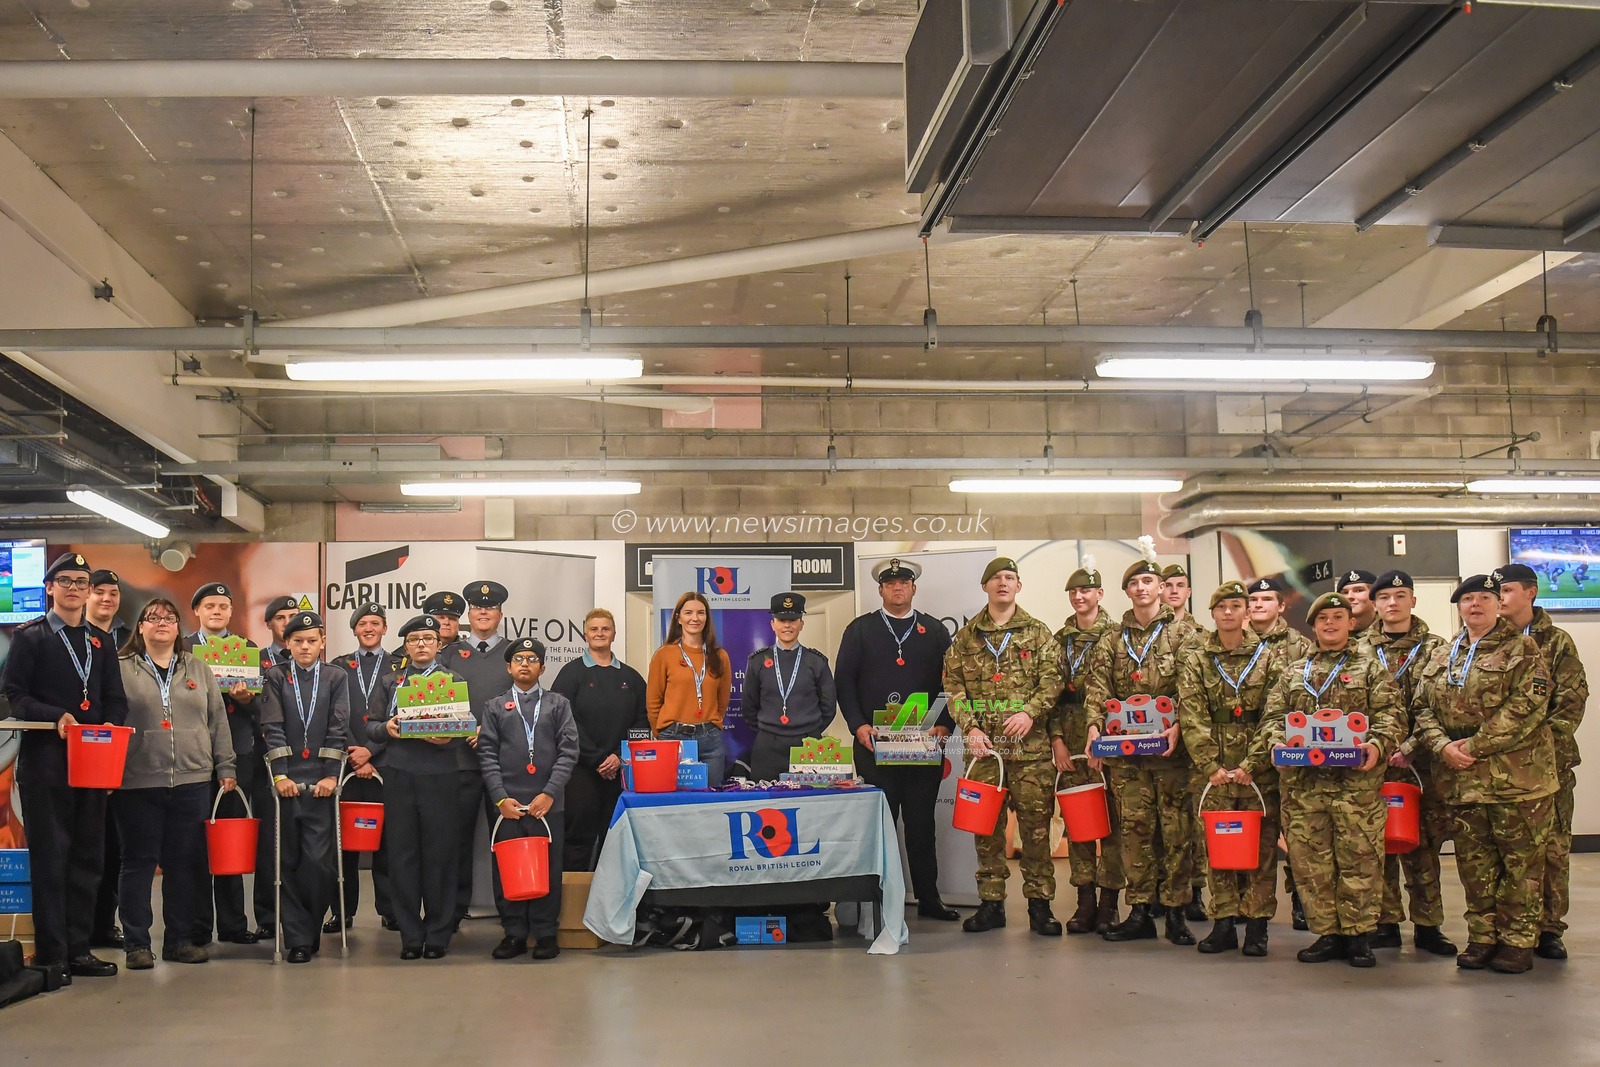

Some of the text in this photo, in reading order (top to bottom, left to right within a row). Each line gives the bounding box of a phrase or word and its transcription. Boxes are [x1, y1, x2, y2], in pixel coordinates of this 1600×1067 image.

[794, 559, 832, 574] ROOM
[326, 583, 427, 610] CARLING
[504, 617, 538, 640] IVE
[734, 669, 746, 679] th
[412, 706, 431, 714] POPPY
[1097, 741, 1161, 752] Poppy Appeal
[1281, 751, 1356, 760] Poppy Appeal
[791, 860, 821, 868] LEGION
